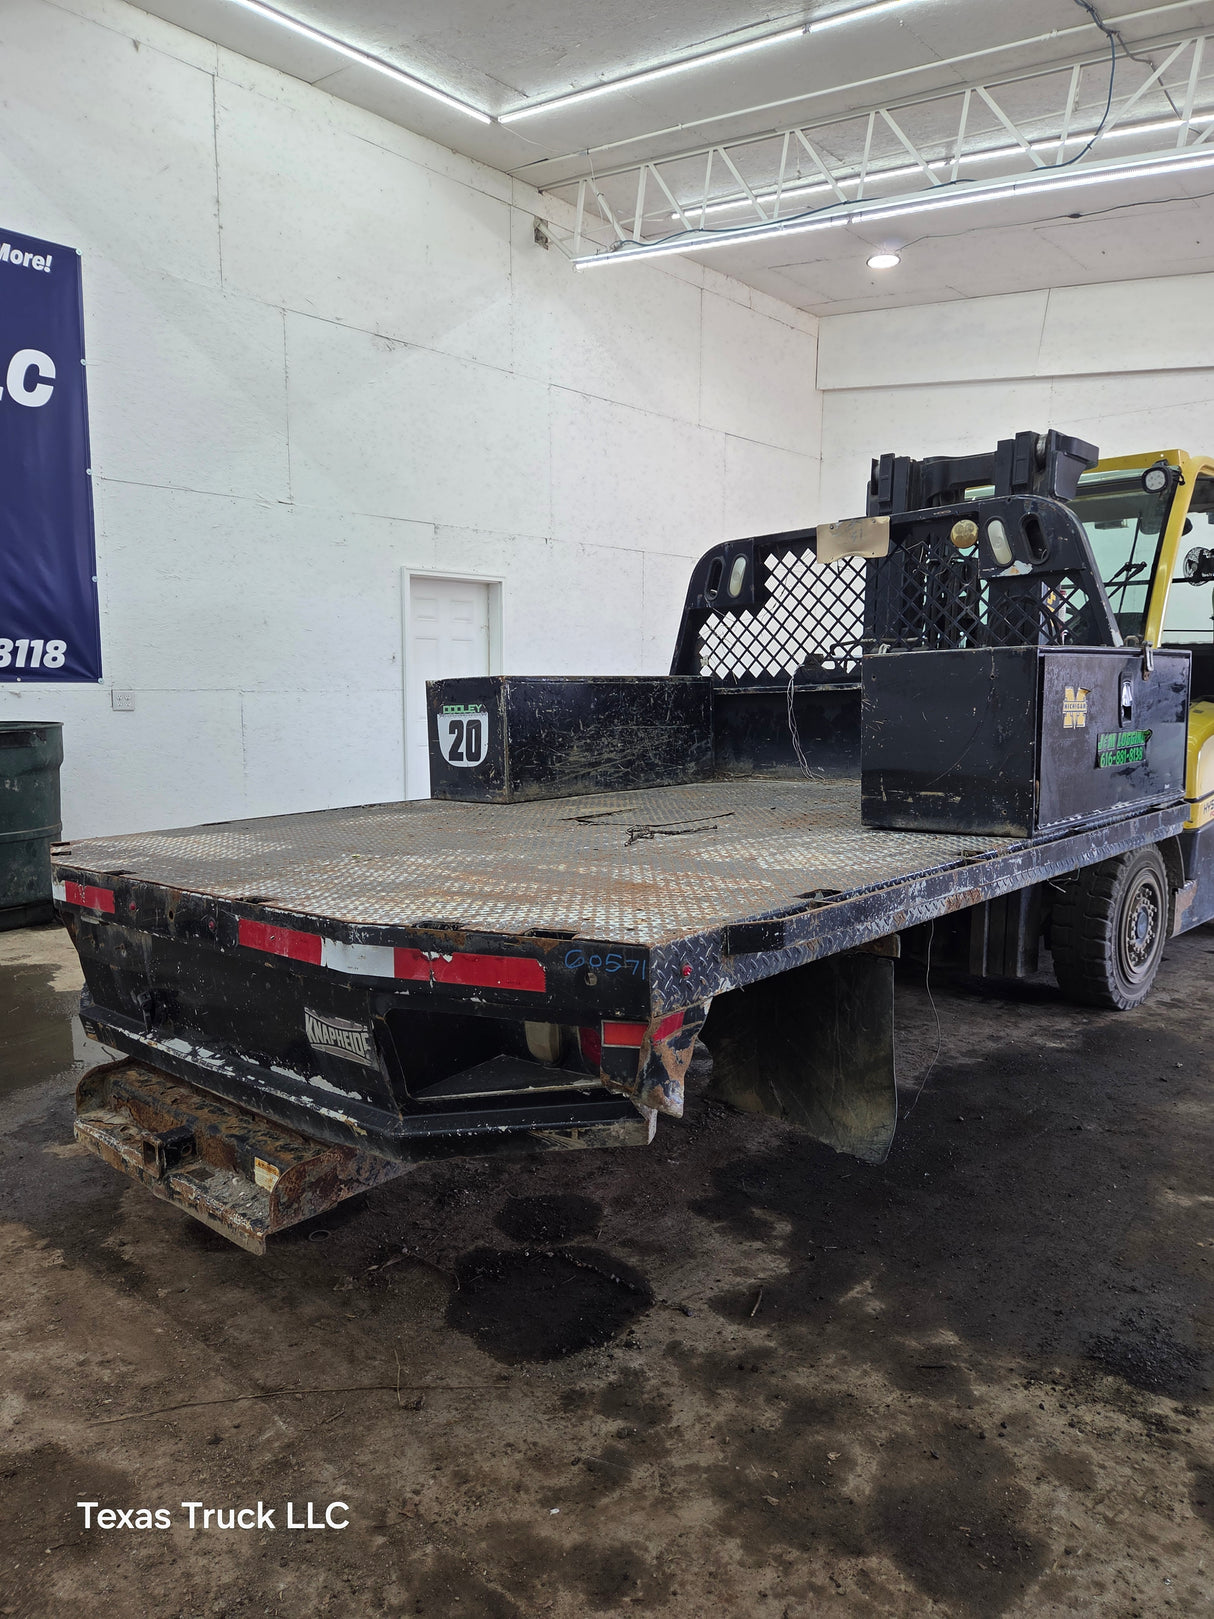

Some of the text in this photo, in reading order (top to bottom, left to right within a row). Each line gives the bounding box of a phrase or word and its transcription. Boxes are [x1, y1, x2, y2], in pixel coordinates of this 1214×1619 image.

[0, 349, 56, 408] C
[448, 719, 482, 762] 20
[564, 949, 647, 981] 60571
[304, 1012, 371, 1058] KNAPHEIDE
